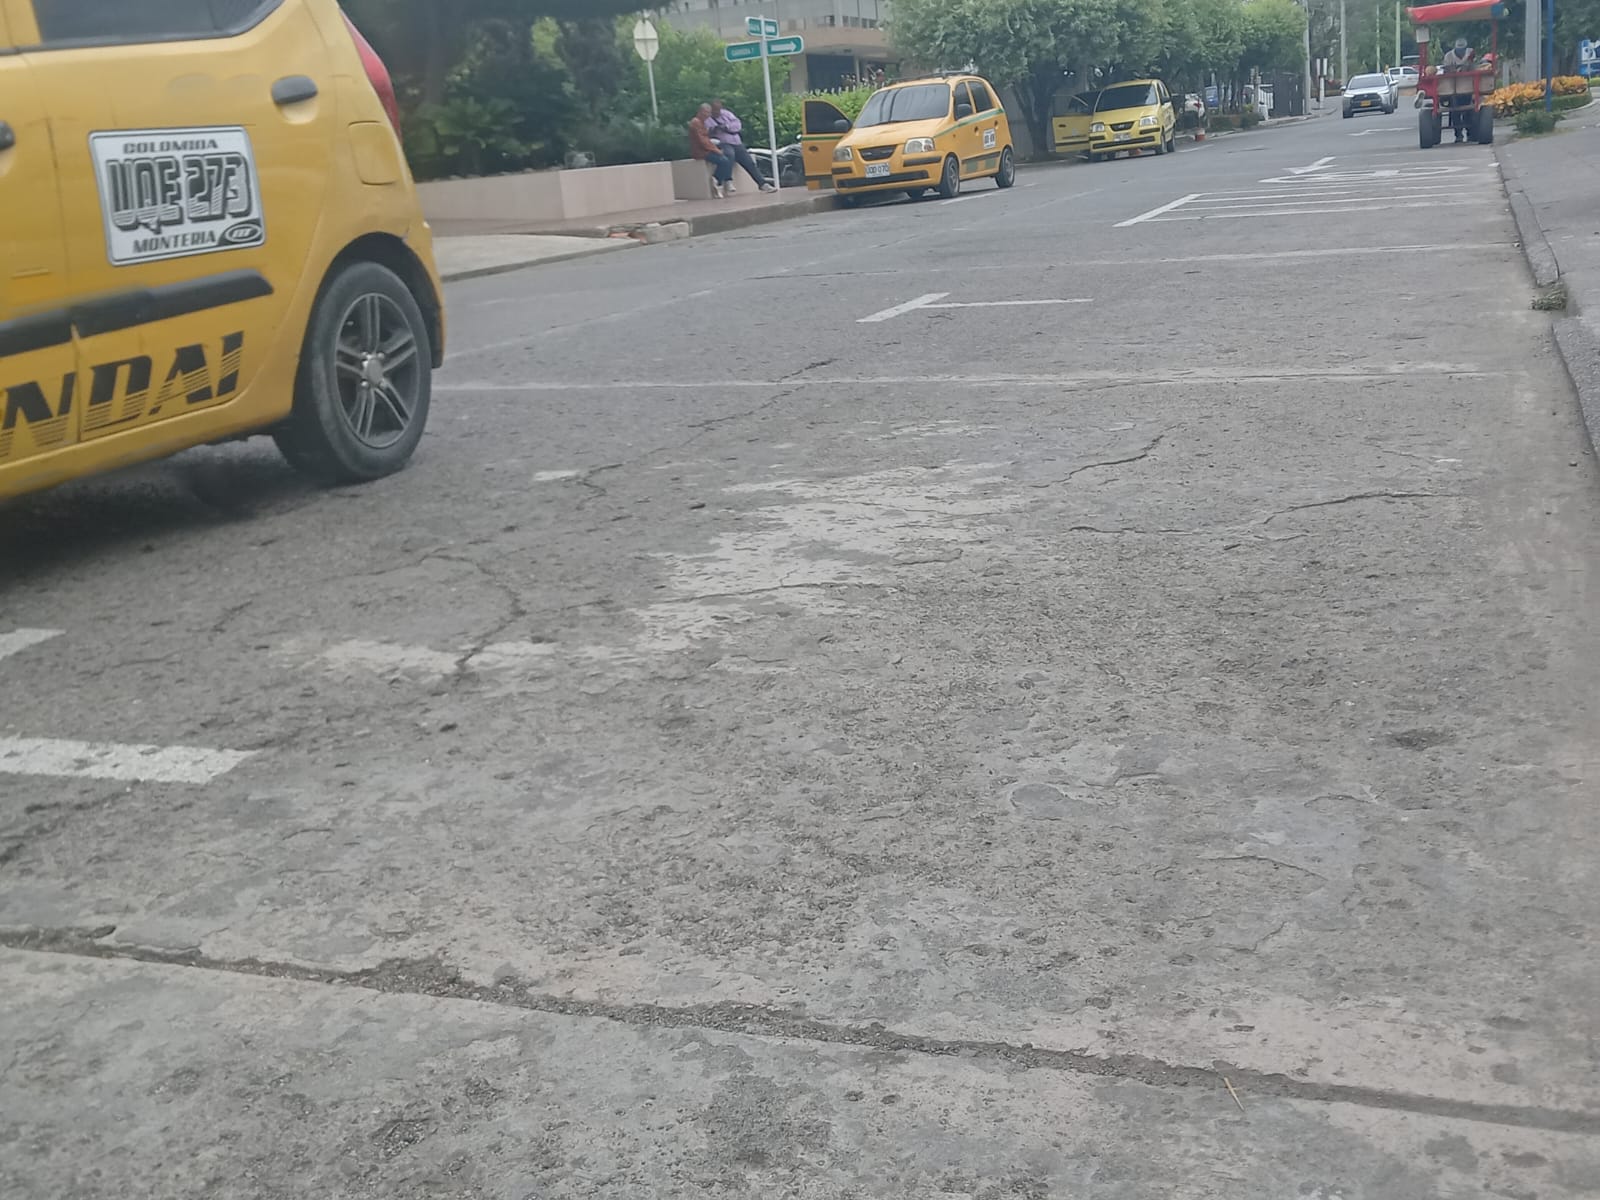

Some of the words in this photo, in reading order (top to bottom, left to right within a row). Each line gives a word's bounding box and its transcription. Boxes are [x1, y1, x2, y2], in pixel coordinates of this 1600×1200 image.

[123, 139, 218, 154] COLOMBIA
[105, 155, 184, 235] UQE
[182, 152, 252, 223] 273
[132, 230, 216, 254] MONTERIA
[0, 331, 244, 458] NDAI
